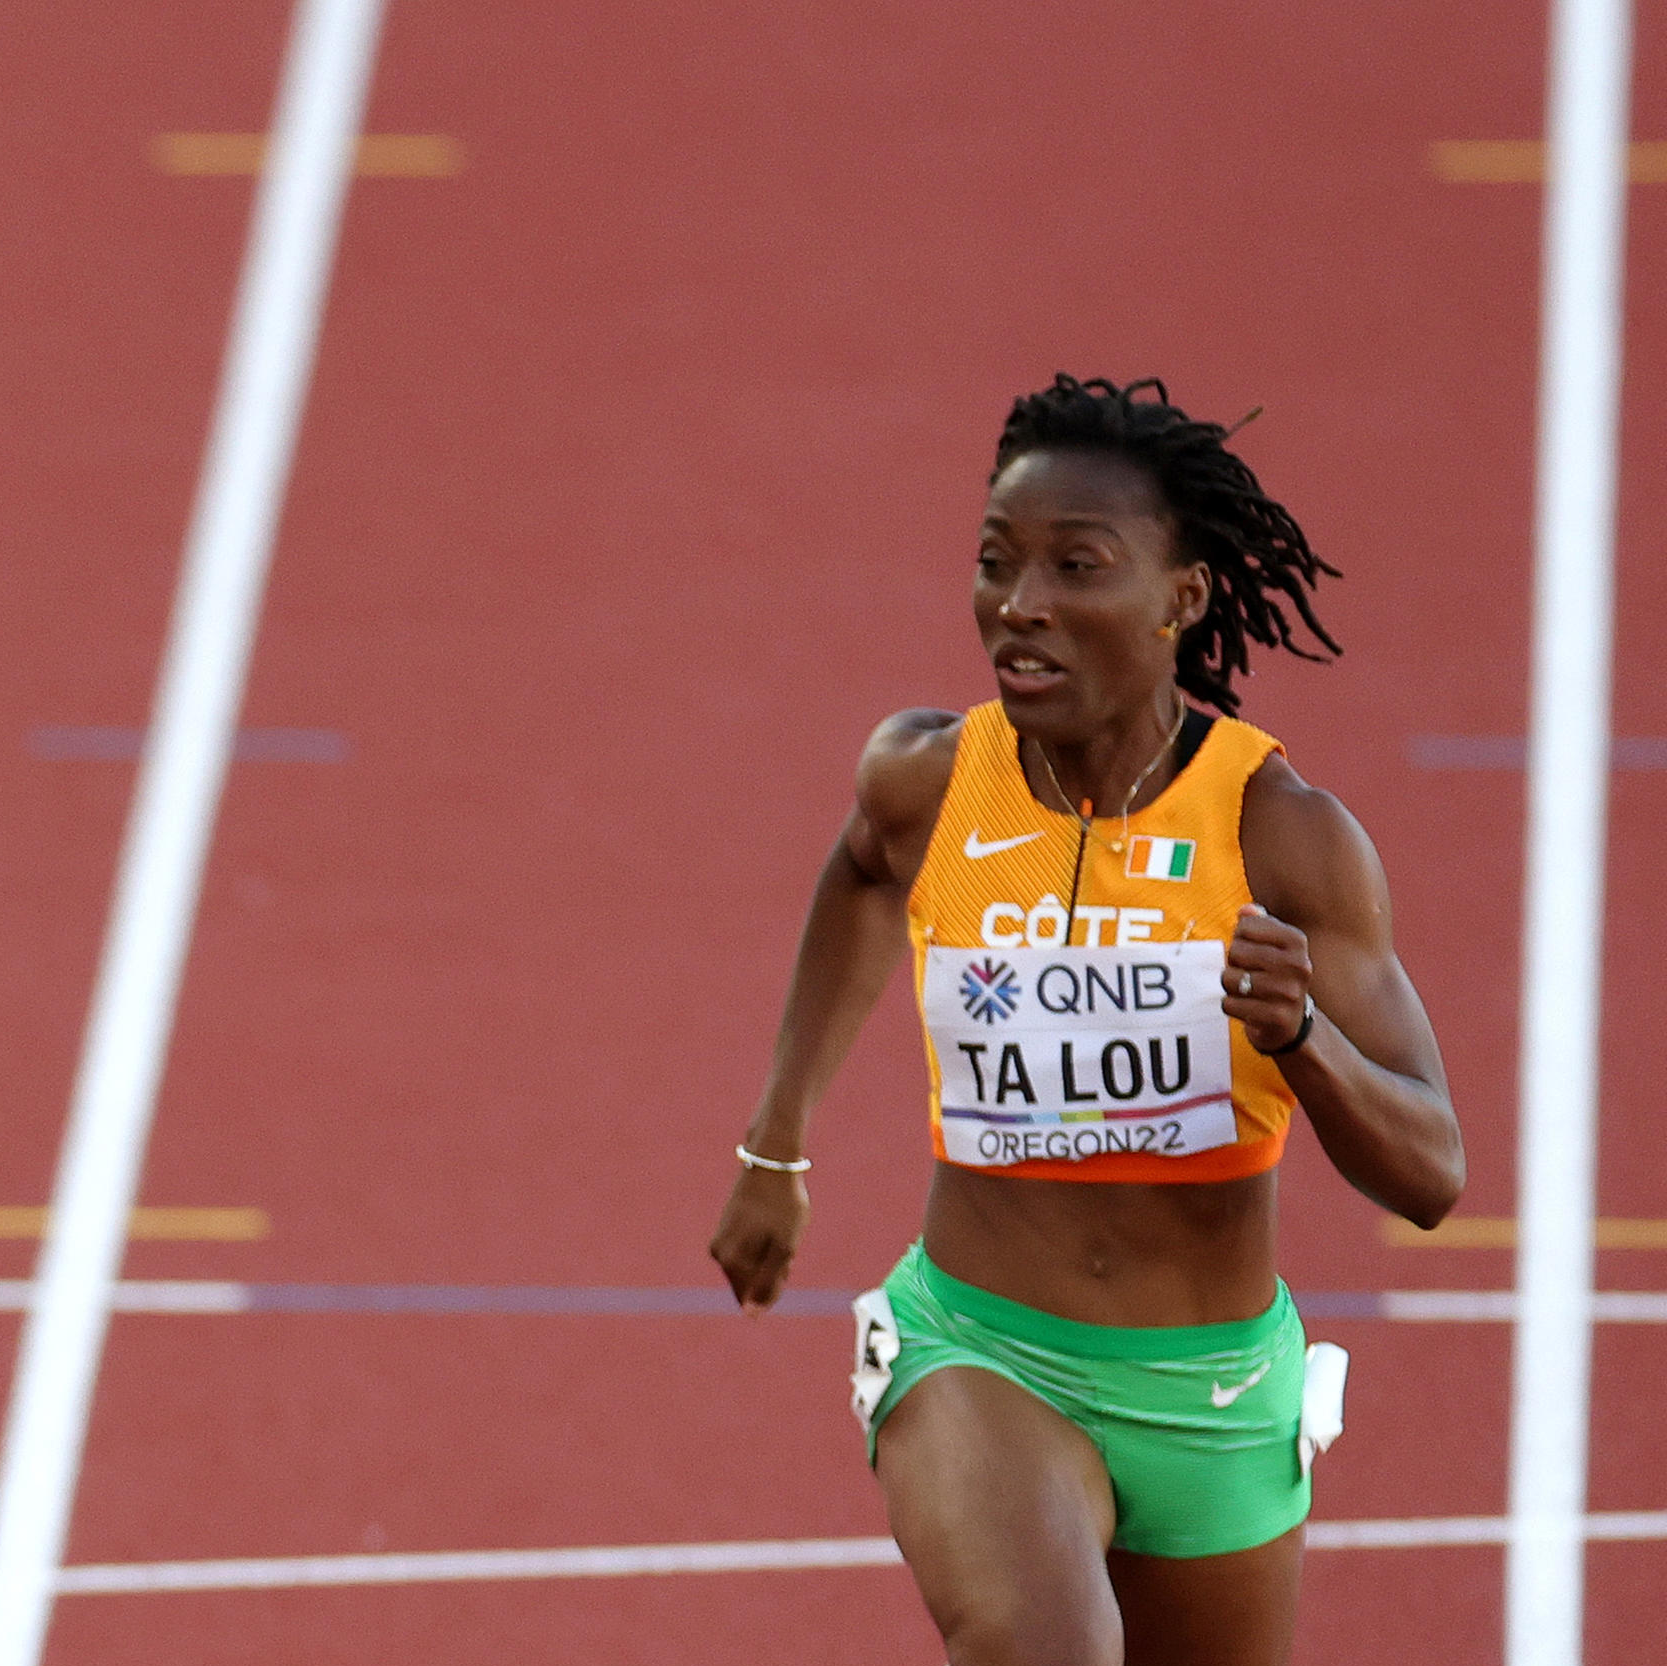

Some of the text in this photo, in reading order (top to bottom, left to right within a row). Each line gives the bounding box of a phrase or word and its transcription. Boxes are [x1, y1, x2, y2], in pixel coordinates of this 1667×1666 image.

[979, 893, 1164, 948] CÔTE
[1036, 962, 1176, 1015] QNB
[958, 1035, 1192, 1105] TA LOU
[978, 1120, 1184, 1161] OREGON22
